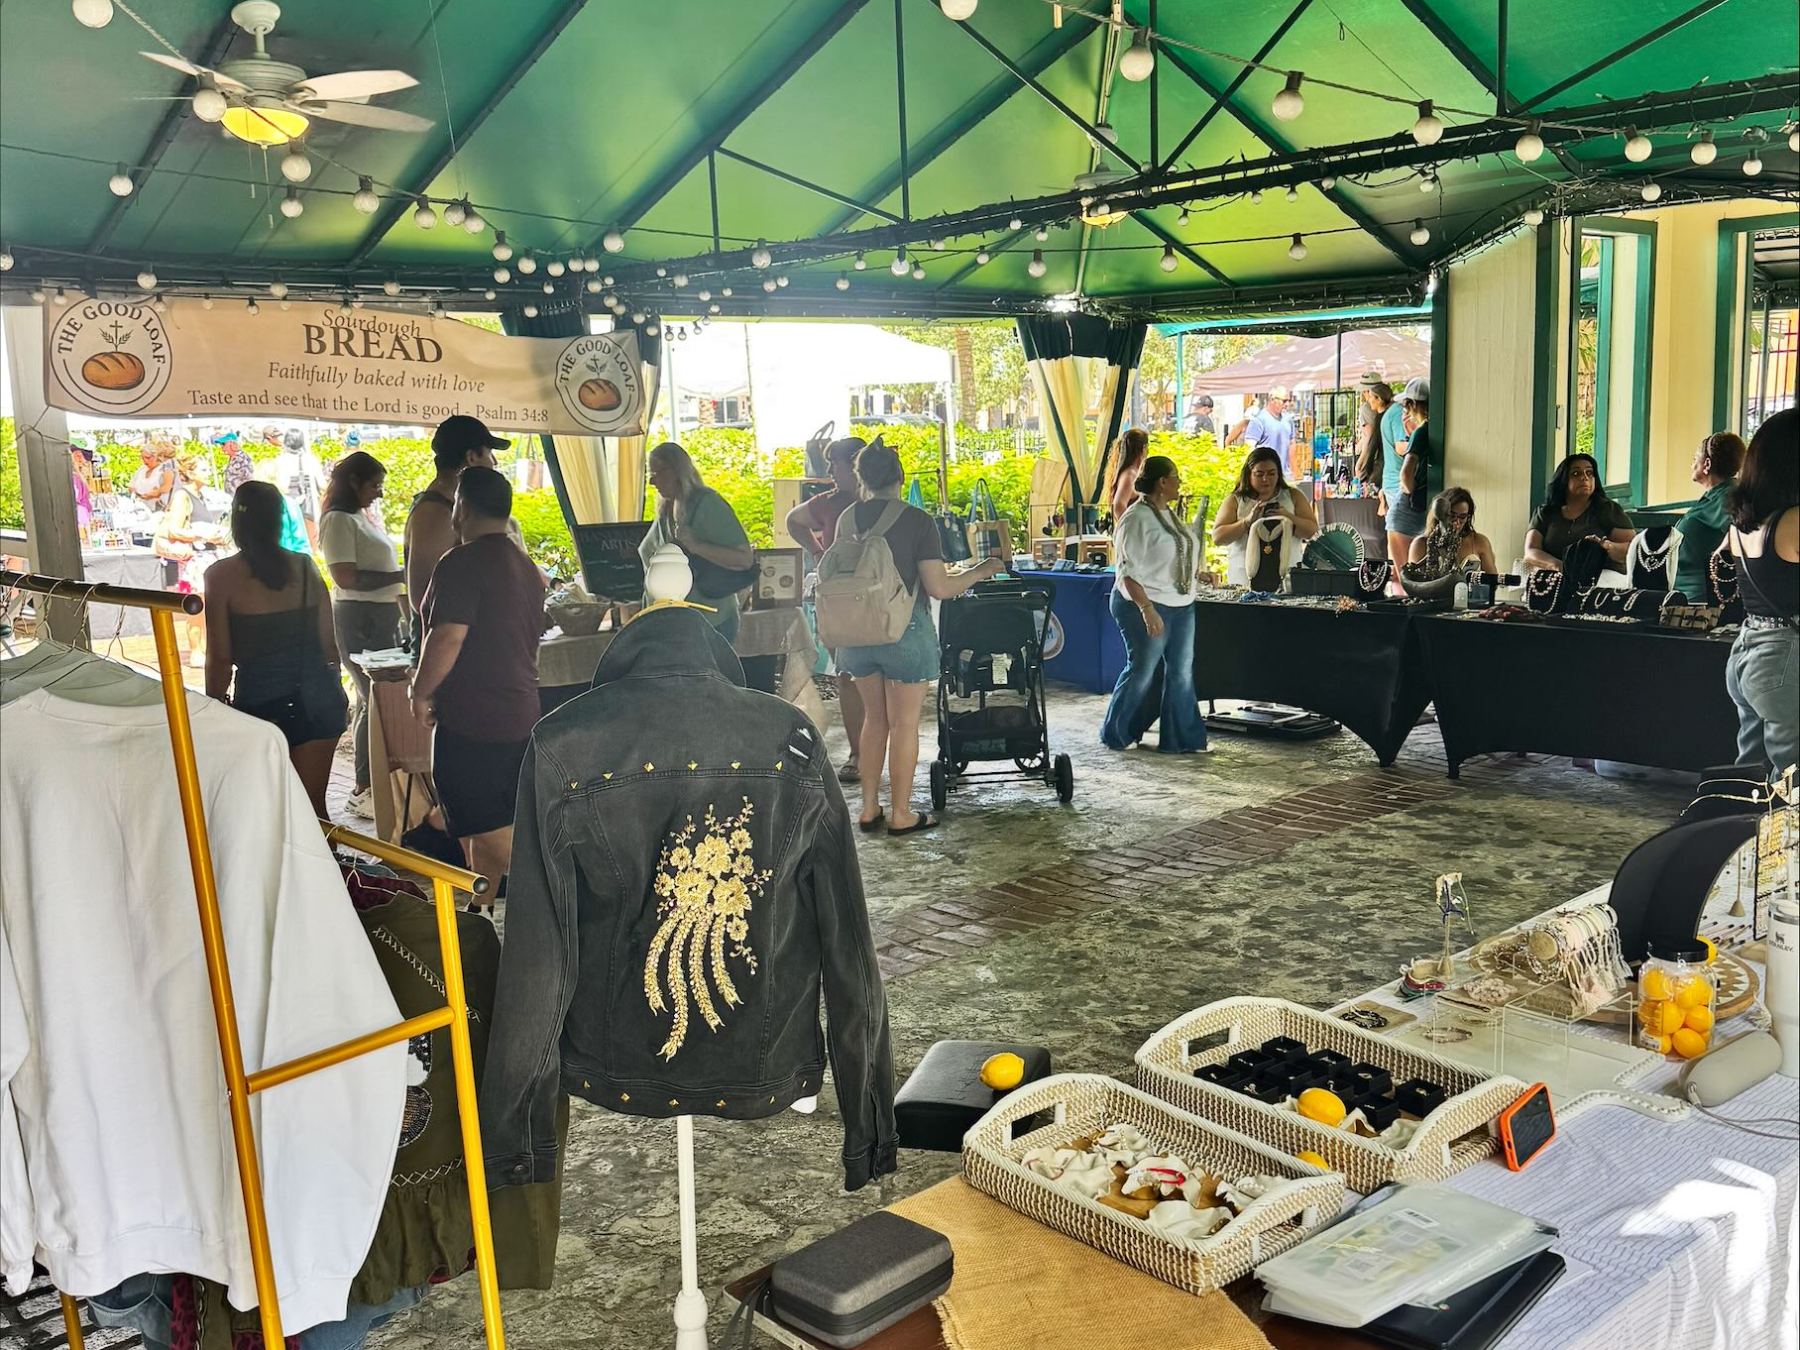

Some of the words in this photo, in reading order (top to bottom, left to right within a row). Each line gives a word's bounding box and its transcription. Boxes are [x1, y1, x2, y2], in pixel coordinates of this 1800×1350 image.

[57, 317, 83, 354] THE
[82, 301, 143, 320] GOOD
[142, 316, 166, 365] LOAF
[321, 308, 421, 341] Sourdough
[302, 323, 443, 363] BREAD
[267, 361, 348, 389] Faithfully
[353, 367, 406, 388] baked
[411, 373, 448, 391] with
[452, 374, 486, 393] love
[560, 353, 577, 383] THE
[576, 339, 611, 356] GOOD
[614, 352, 635, 393] LOAF
[187, 389, 233, 406] Taste
[238, 389, 270, 406] and
[274, 394, 299, 407] see
[302, 392, 328, 410] that
[333, 395, 359, 412] the
[364, 397, 401, 414] Lord
[406, 400, 418, 415] is
[422, 402, 460, 420] good
[476, 404, 518, 421] Psalm
[522, 408, 549, 422] 34:8
